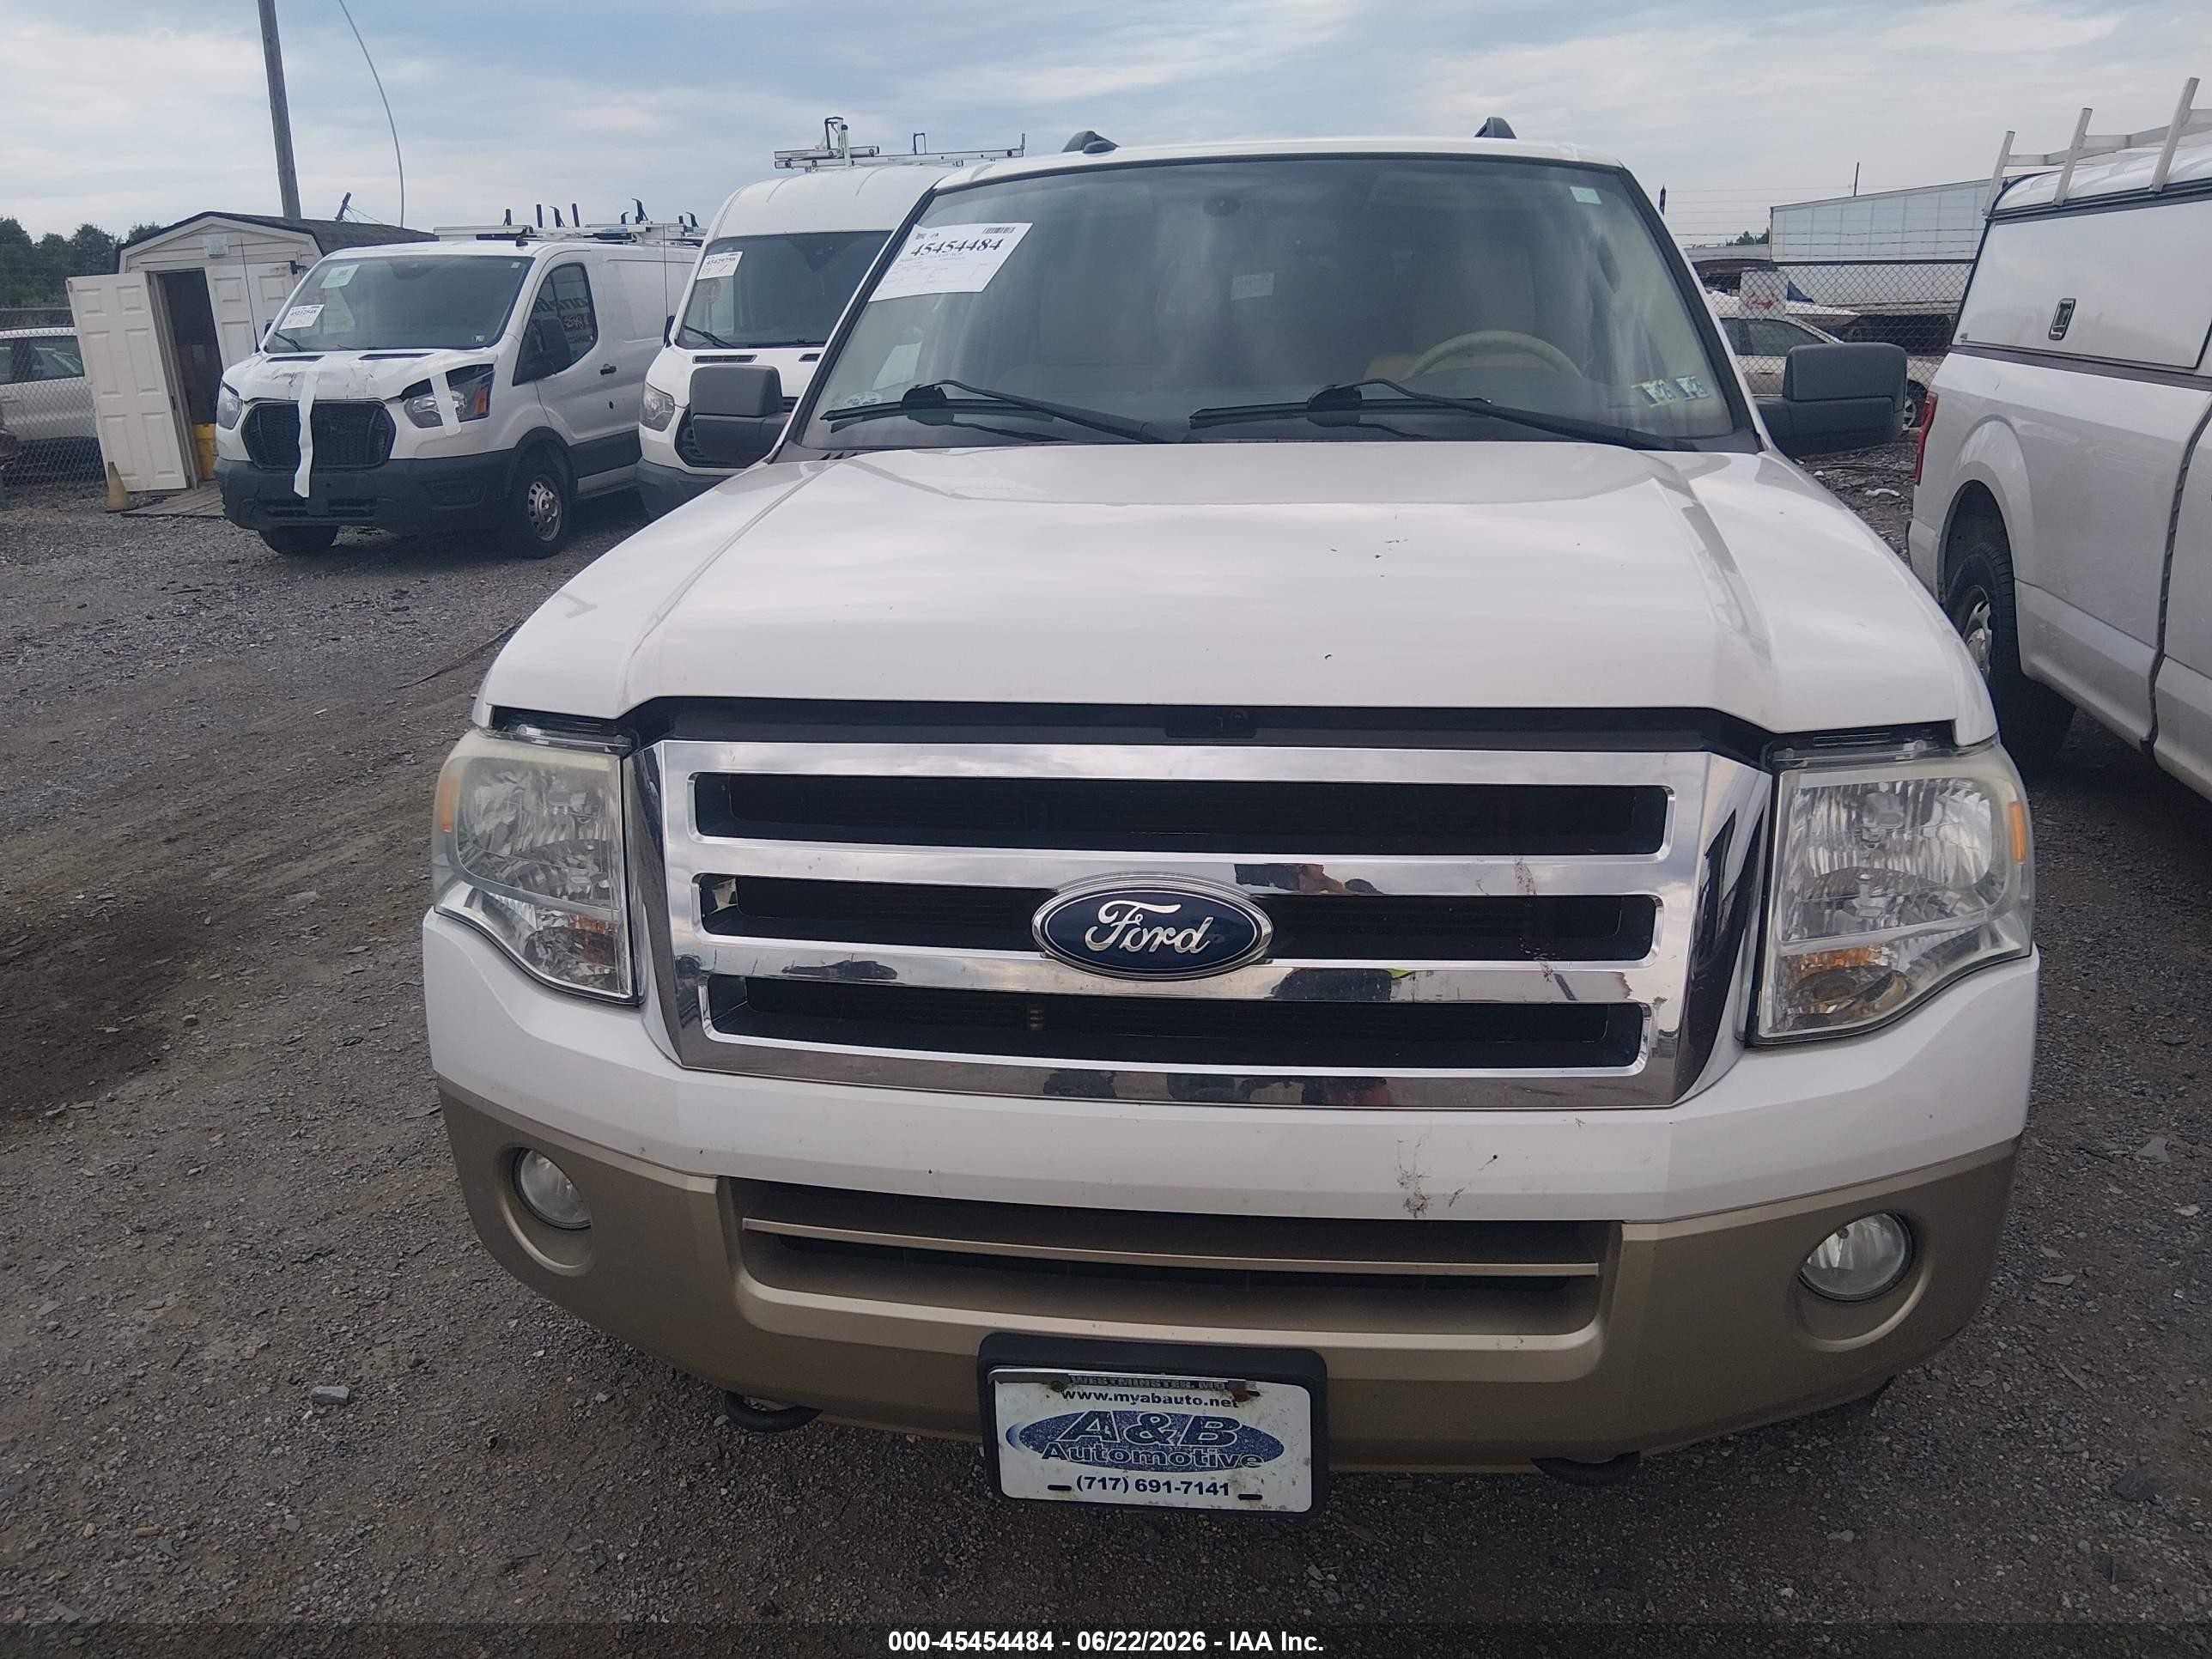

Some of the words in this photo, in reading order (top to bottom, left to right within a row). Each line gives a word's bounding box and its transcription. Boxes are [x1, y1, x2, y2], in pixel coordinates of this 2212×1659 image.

[910, 238, 1005, 256] 45454484
[1085, 900, 1214, 954] Ford
[1061, 1390, 1239, 1408] www.myabauto.net
[1056, 1409, 1243, 1447] A&B
[1042, 1442, 1264, 1468] Automotive
[1076, 1474, 1130, 1492] (717)
[1135, 1477, 1231, 1497] 691-7141
